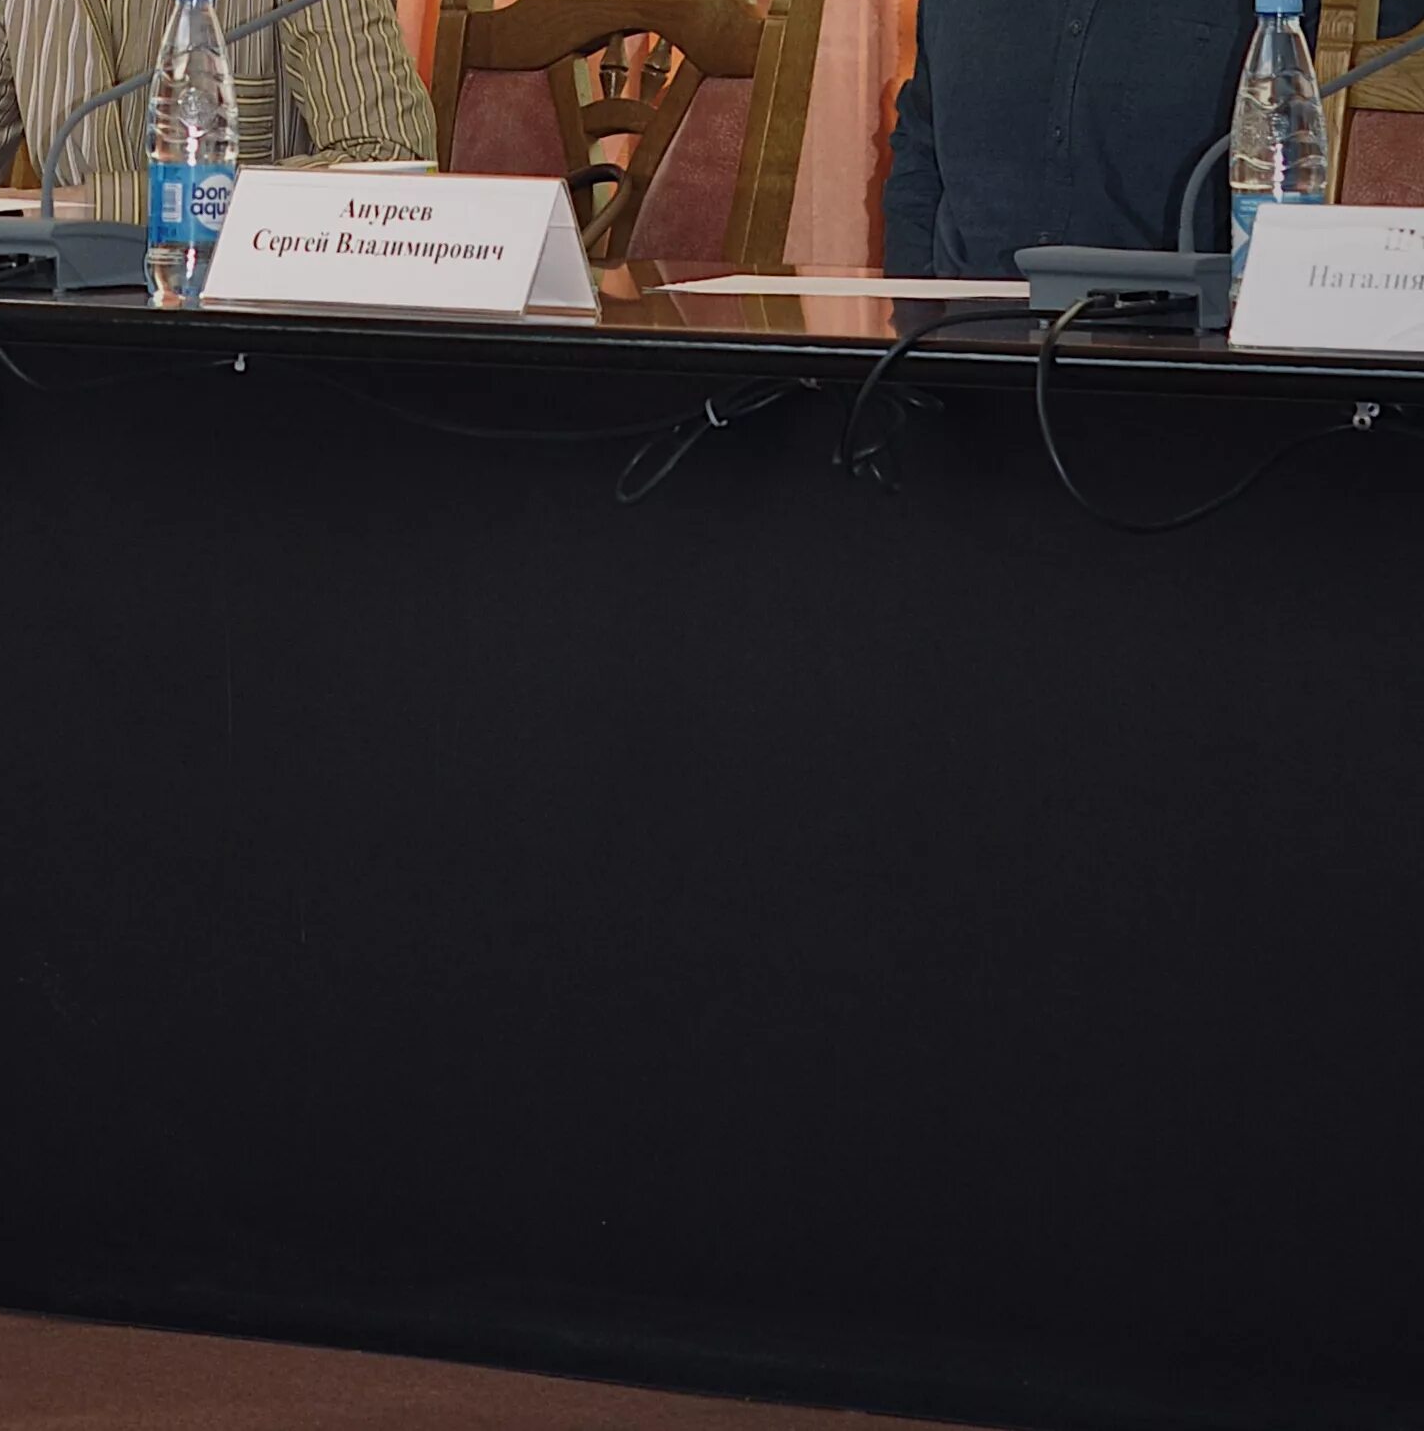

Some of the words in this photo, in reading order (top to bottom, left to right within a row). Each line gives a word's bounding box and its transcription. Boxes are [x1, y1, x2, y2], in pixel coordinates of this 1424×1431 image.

[191, 183, 228, 201] bon
[190, 202, 229, 220] aqu
[339, 197, 434, 226] Ануреев
[252, 228, 329, 258] Сергей
[336, 232, 504, 265] Владимирович
